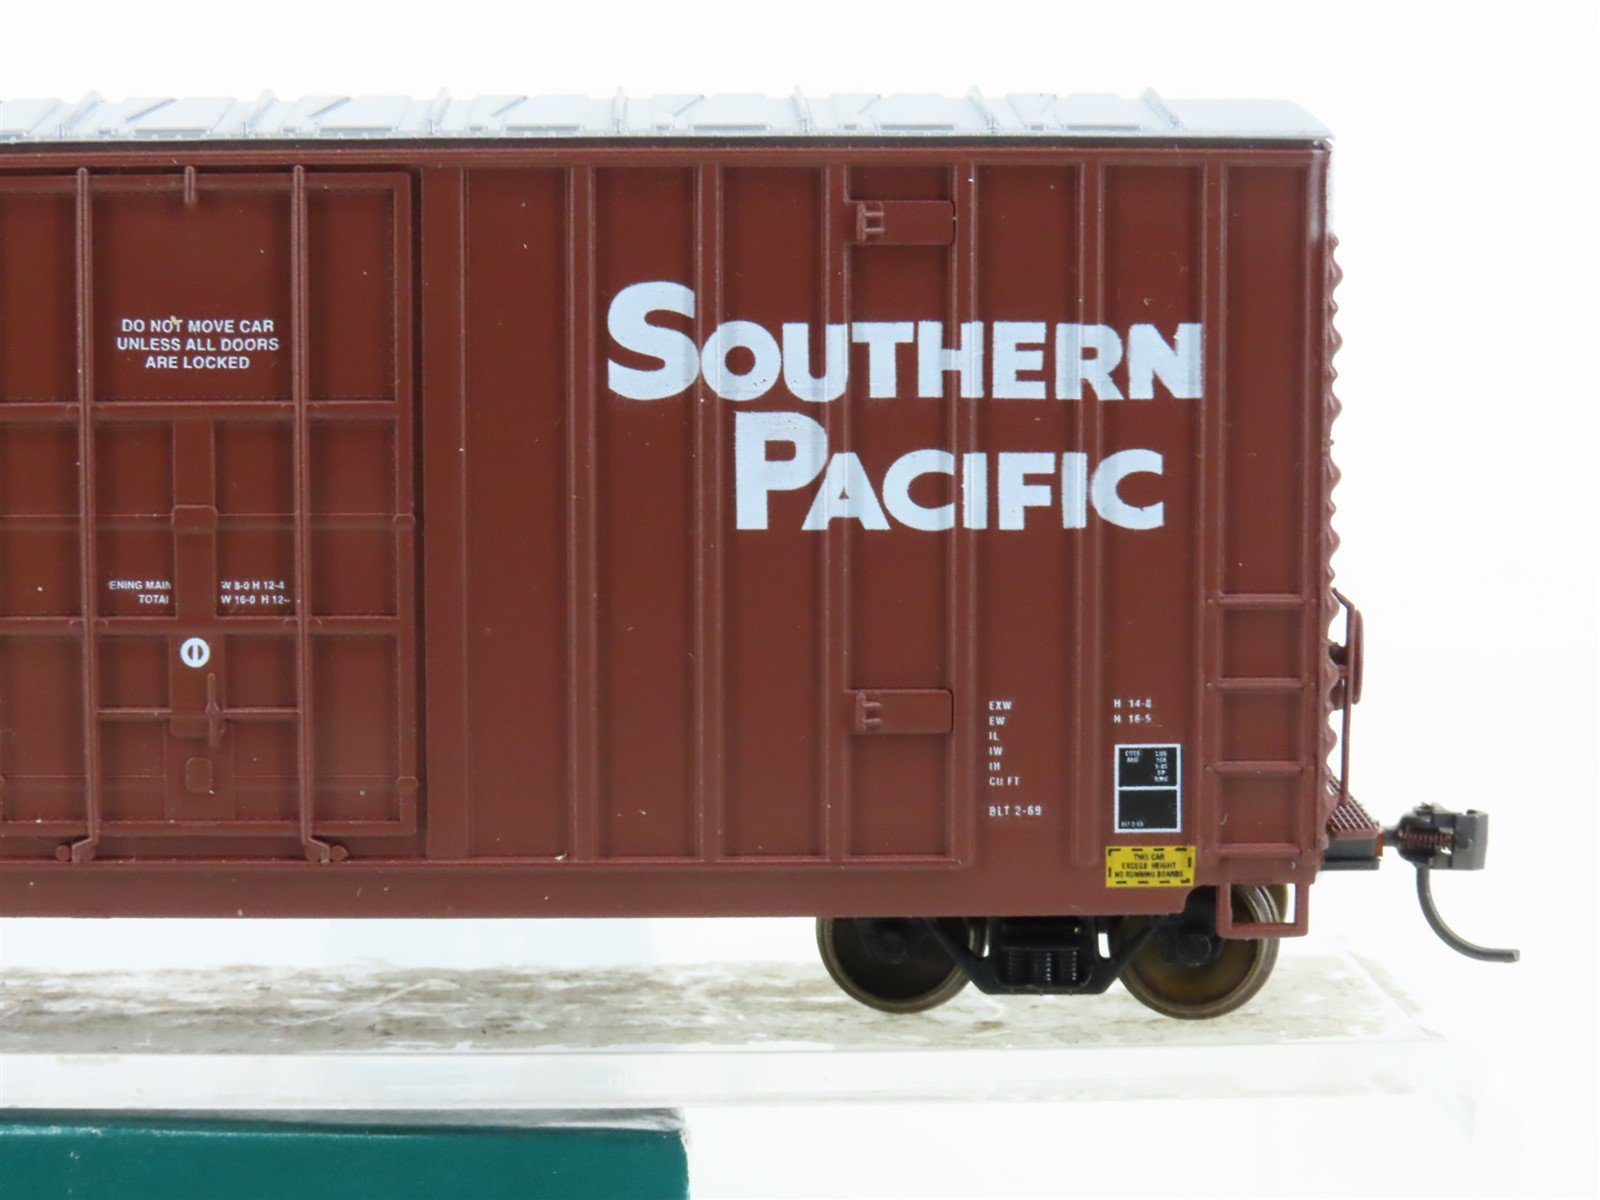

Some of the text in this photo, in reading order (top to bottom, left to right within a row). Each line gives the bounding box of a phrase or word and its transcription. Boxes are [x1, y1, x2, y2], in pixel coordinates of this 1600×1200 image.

[121, 317, 274, 333] DO NOT MOVE CAR
[116, 337, 279, 351] UNLESS ALL DOORS
[607, 280, 1203, 402] SOUTHERN
[145, 356, 250, 369] ARE LOCKED
[734, 411, 1164, 531] PACIFIC
[220, 580, 231, 590] W
[252, 580, 260, 590] H
[263, 580, 285, 590] 12-4
[220, 594, 231, 604] W
[234, 594, 256, 605] 16-0
[261, 594, 269, 604] H
[988, 700, 1012, 711] EXW
[1113, 698, 1121, 708] H
[988, 716, 1005, 726] EW
[988, 731, 999, 741] IL
[1007, 776, 1020, 786] FT
[988, 804, 1042, 817] BLT 2-69
